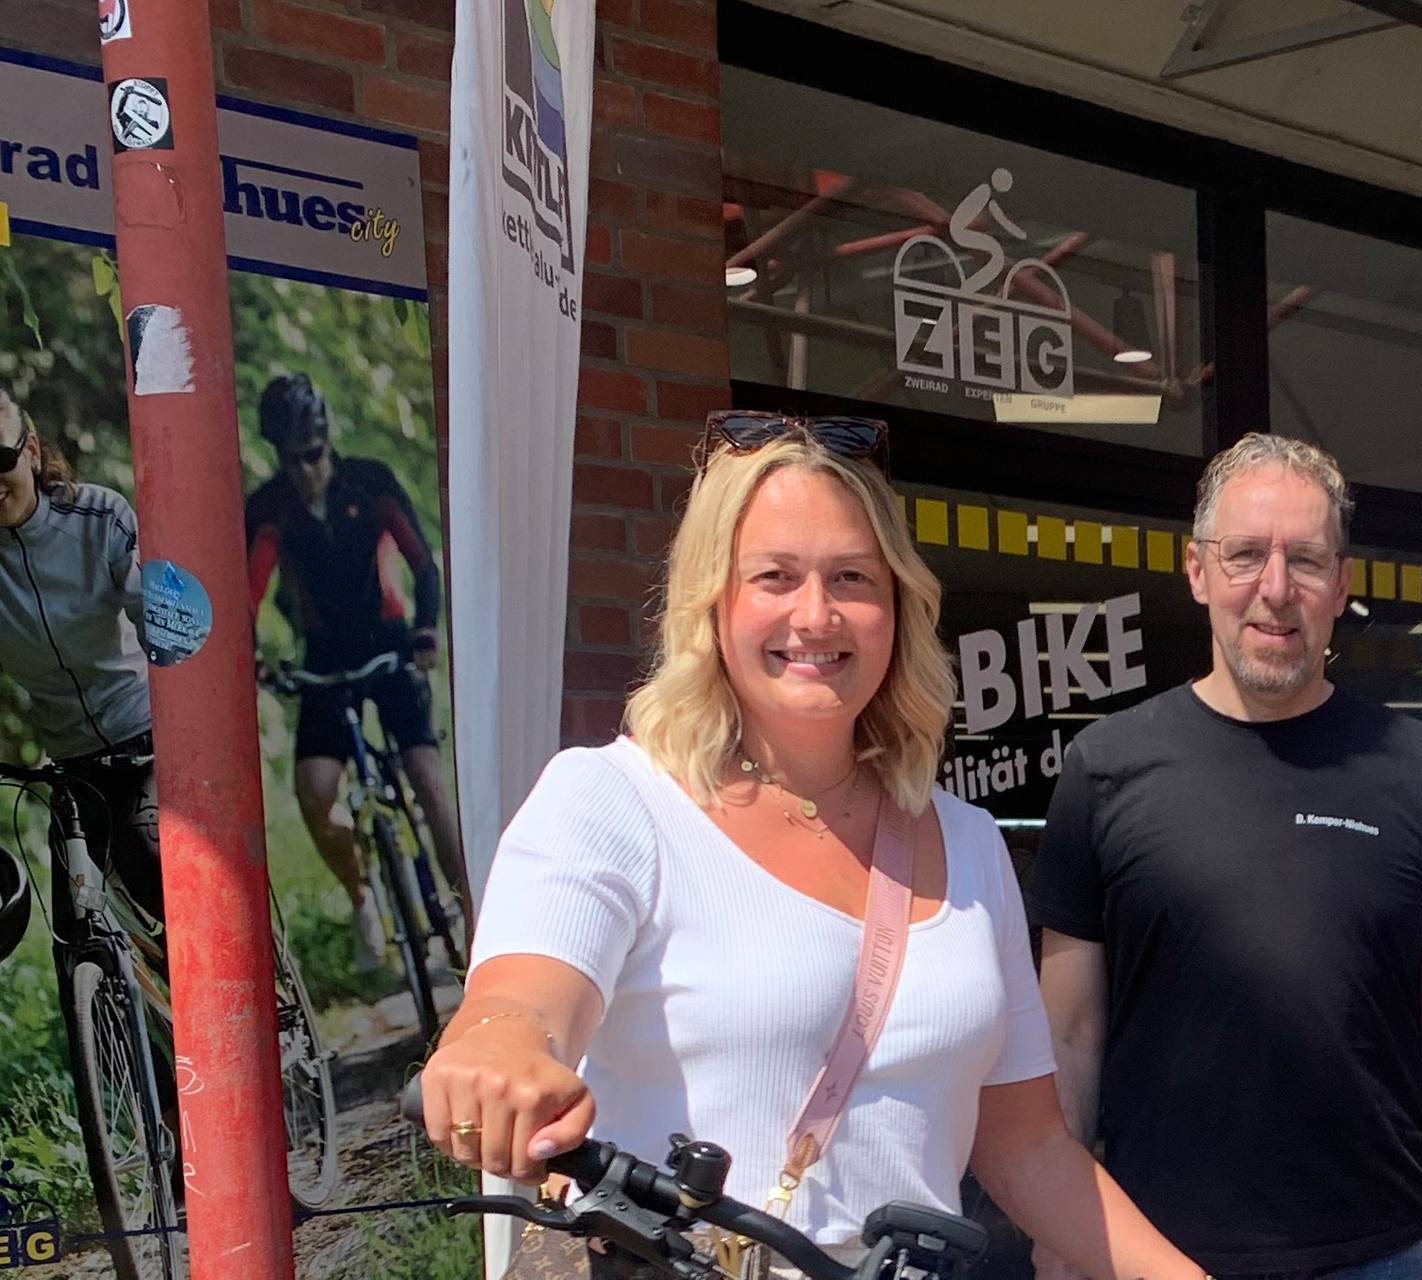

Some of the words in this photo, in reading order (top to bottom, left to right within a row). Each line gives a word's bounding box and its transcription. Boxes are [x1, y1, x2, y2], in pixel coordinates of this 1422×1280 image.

[0, 140, 100, 190] rad
[219, 155, 366, 234] hues
[351, 207, 399, 257] city
[902, 299, 1068, 390] ZEG
[905, 376, 949, 394] ZWEIRAD
[1030, 398, 1066, 413] GRUPPE
[958, 592, 1147, 735] BIKE
[1040, 729, 1076, 778] d
[1296, 813, 1306, 824] D.
[852, 988, 881, 1039] LOUIS
[867, 923, 896, 987] VUITTON
